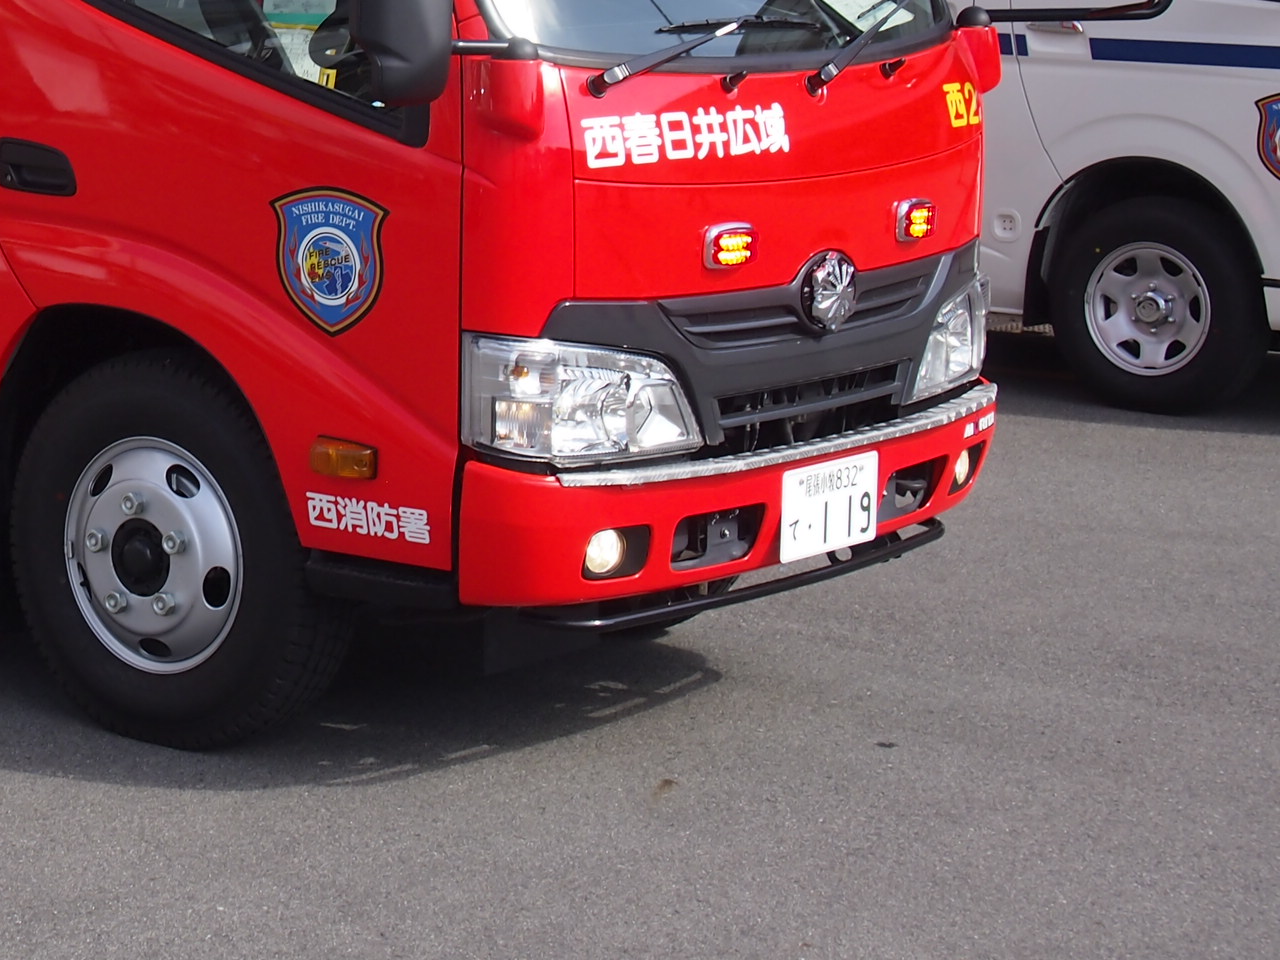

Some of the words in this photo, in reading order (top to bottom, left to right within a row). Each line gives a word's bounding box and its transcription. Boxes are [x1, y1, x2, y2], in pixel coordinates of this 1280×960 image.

[580, 102, 790, 169] 西春日井広域
[292, 201, 364, 222] NISHIKASUGAI
[301, 212, 325, 226] FIRE
[329, 214, 357, 231] DEPT.
[309, 247, 331, 260] FIRE
[310, 254, 351, 271] RESCUE
[305, 491, 431, 545] 西消防署
